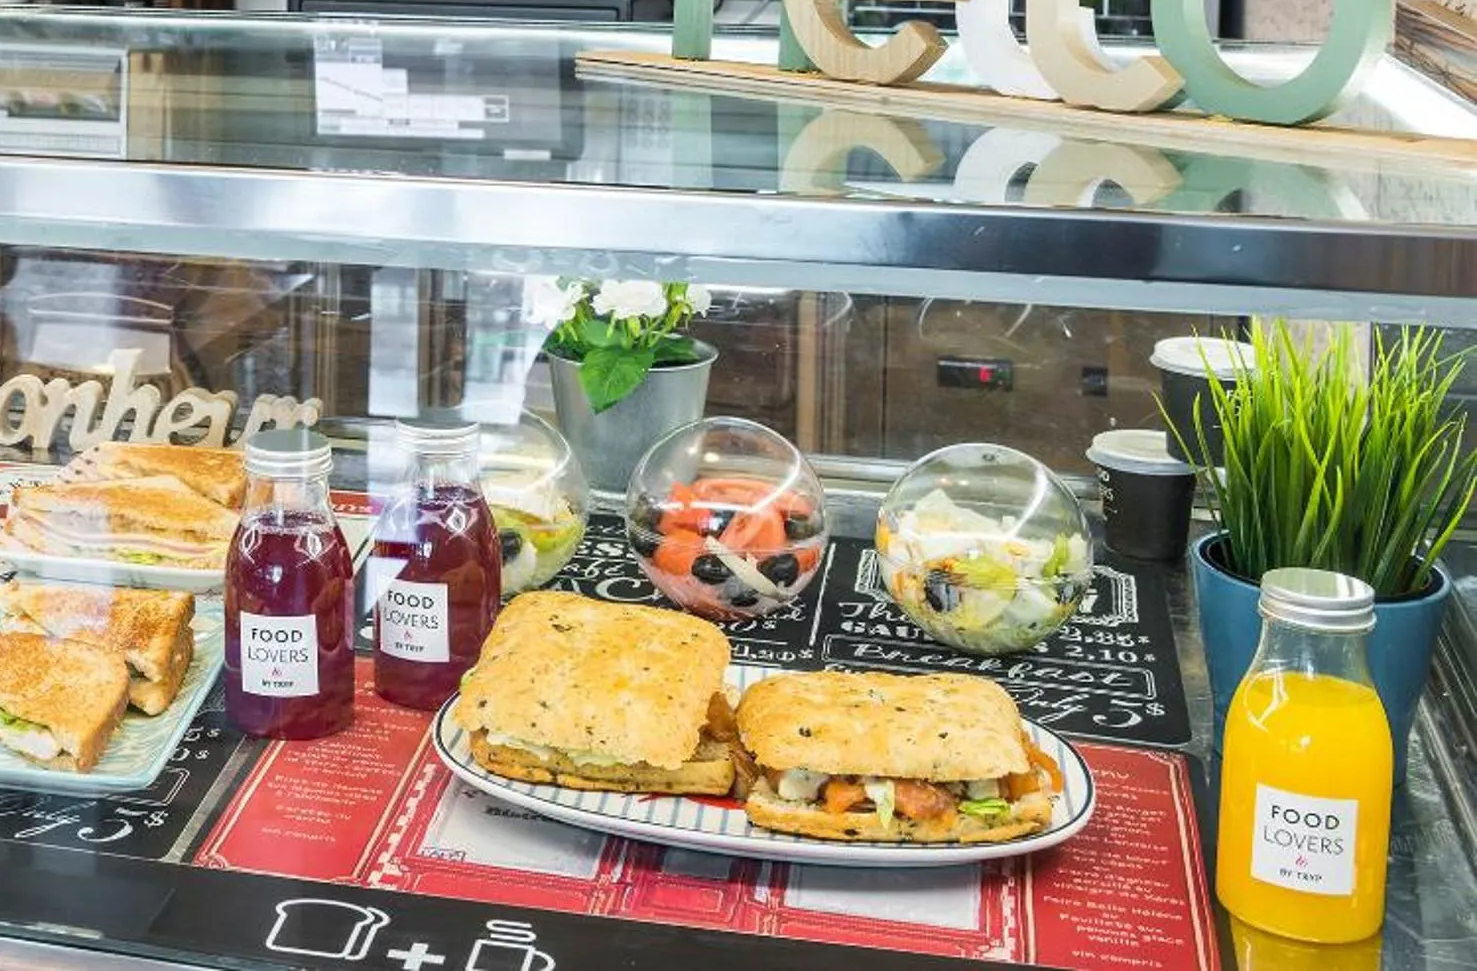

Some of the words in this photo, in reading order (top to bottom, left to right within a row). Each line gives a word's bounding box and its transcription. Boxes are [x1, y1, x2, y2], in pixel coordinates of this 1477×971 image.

[387, 590, 435, 610] FOOD
[251, 627, 303, 643] FOOD
[1271, 805, 1340, 830] FOOD
[1264, 825, 1344, 856] LOVERS
